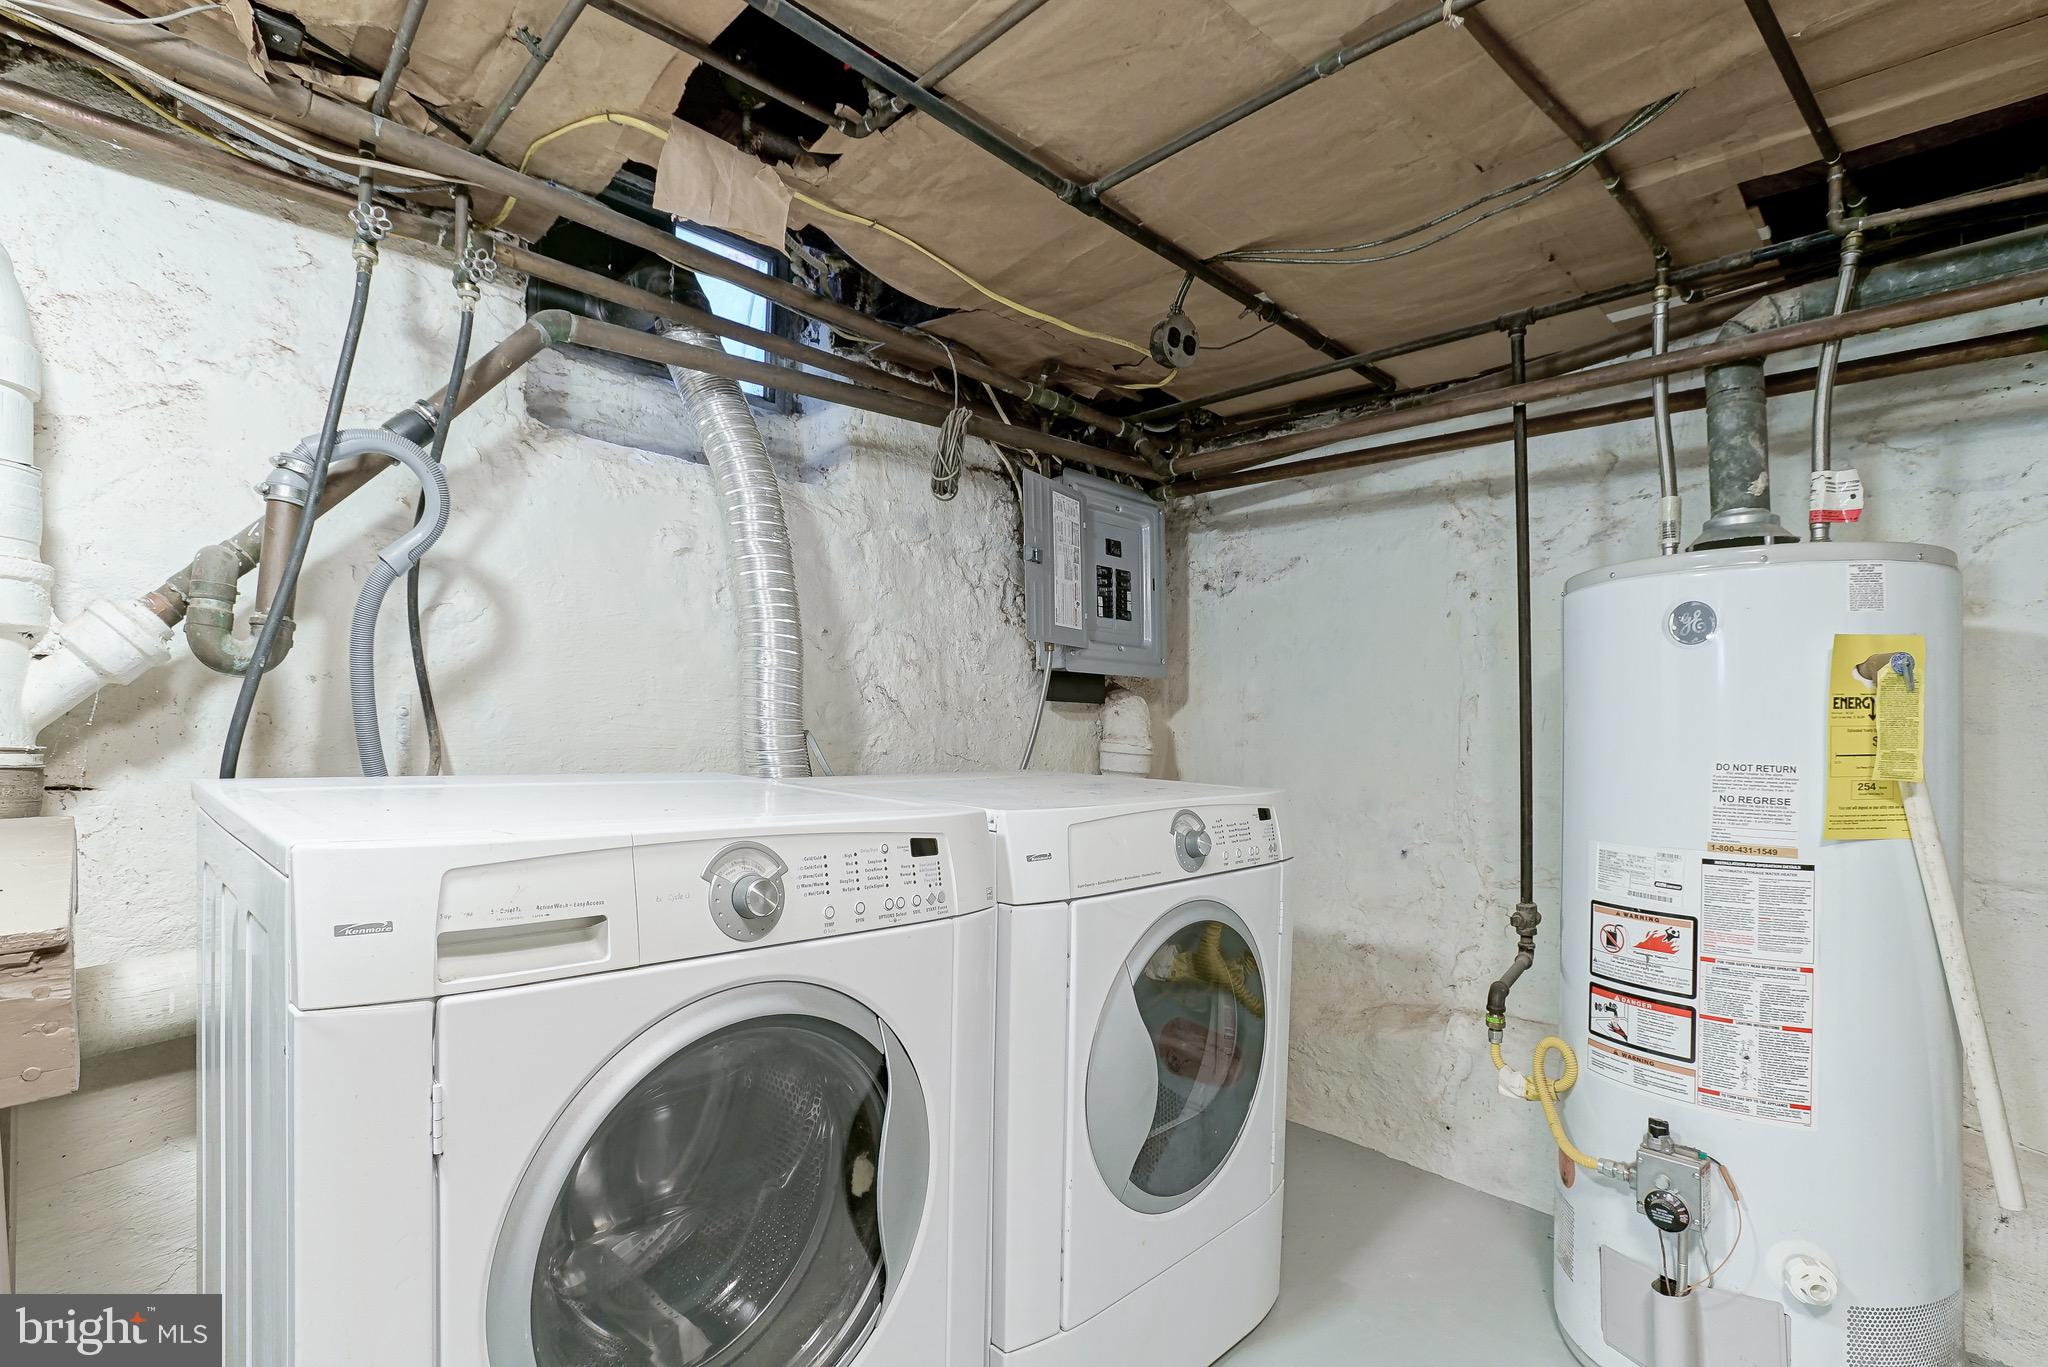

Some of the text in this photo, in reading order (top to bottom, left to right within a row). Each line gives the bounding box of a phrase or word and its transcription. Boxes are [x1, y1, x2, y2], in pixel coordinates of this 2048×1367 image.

[1716, 763, 1797, 774] DO NOT RETURN
[1857, 782, 1876, 791] 254
[1720, 794, 1791, 806] NO REGRESE
[1711, 844, 1778, 856] 1-800-431-1549
[1624, 913, 1660, 923] WARNING
[343, 924, 393, 936] Kenmore
[1622, 998, 1653, 1010] DANGER
[1622, 1052, 1655, 1067] WARNING
